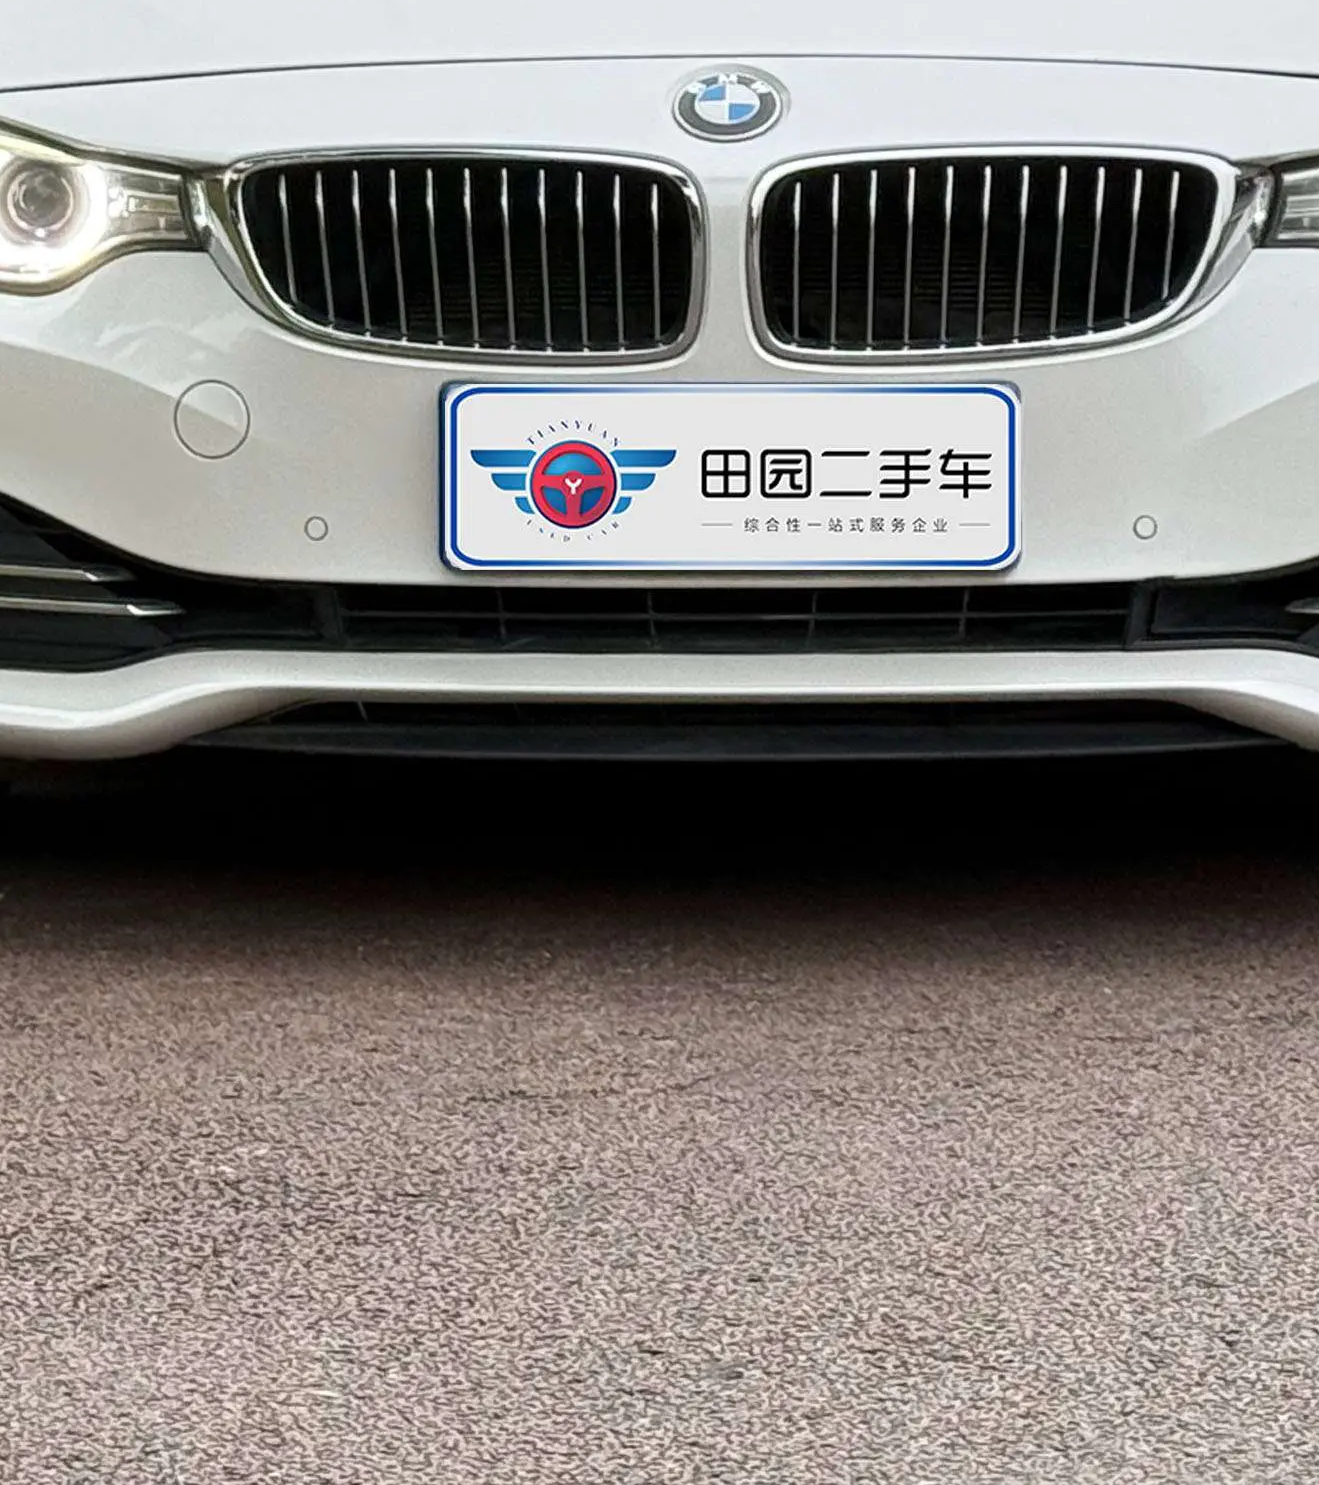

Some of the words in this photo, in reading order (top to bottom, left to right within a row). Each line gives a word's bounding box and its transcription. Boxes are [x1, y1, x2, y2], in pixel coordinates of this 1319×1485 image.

[700, 448, 993, 500] 田园二手车
[743, 517, 949, 534] 综合性一站式服务企业
